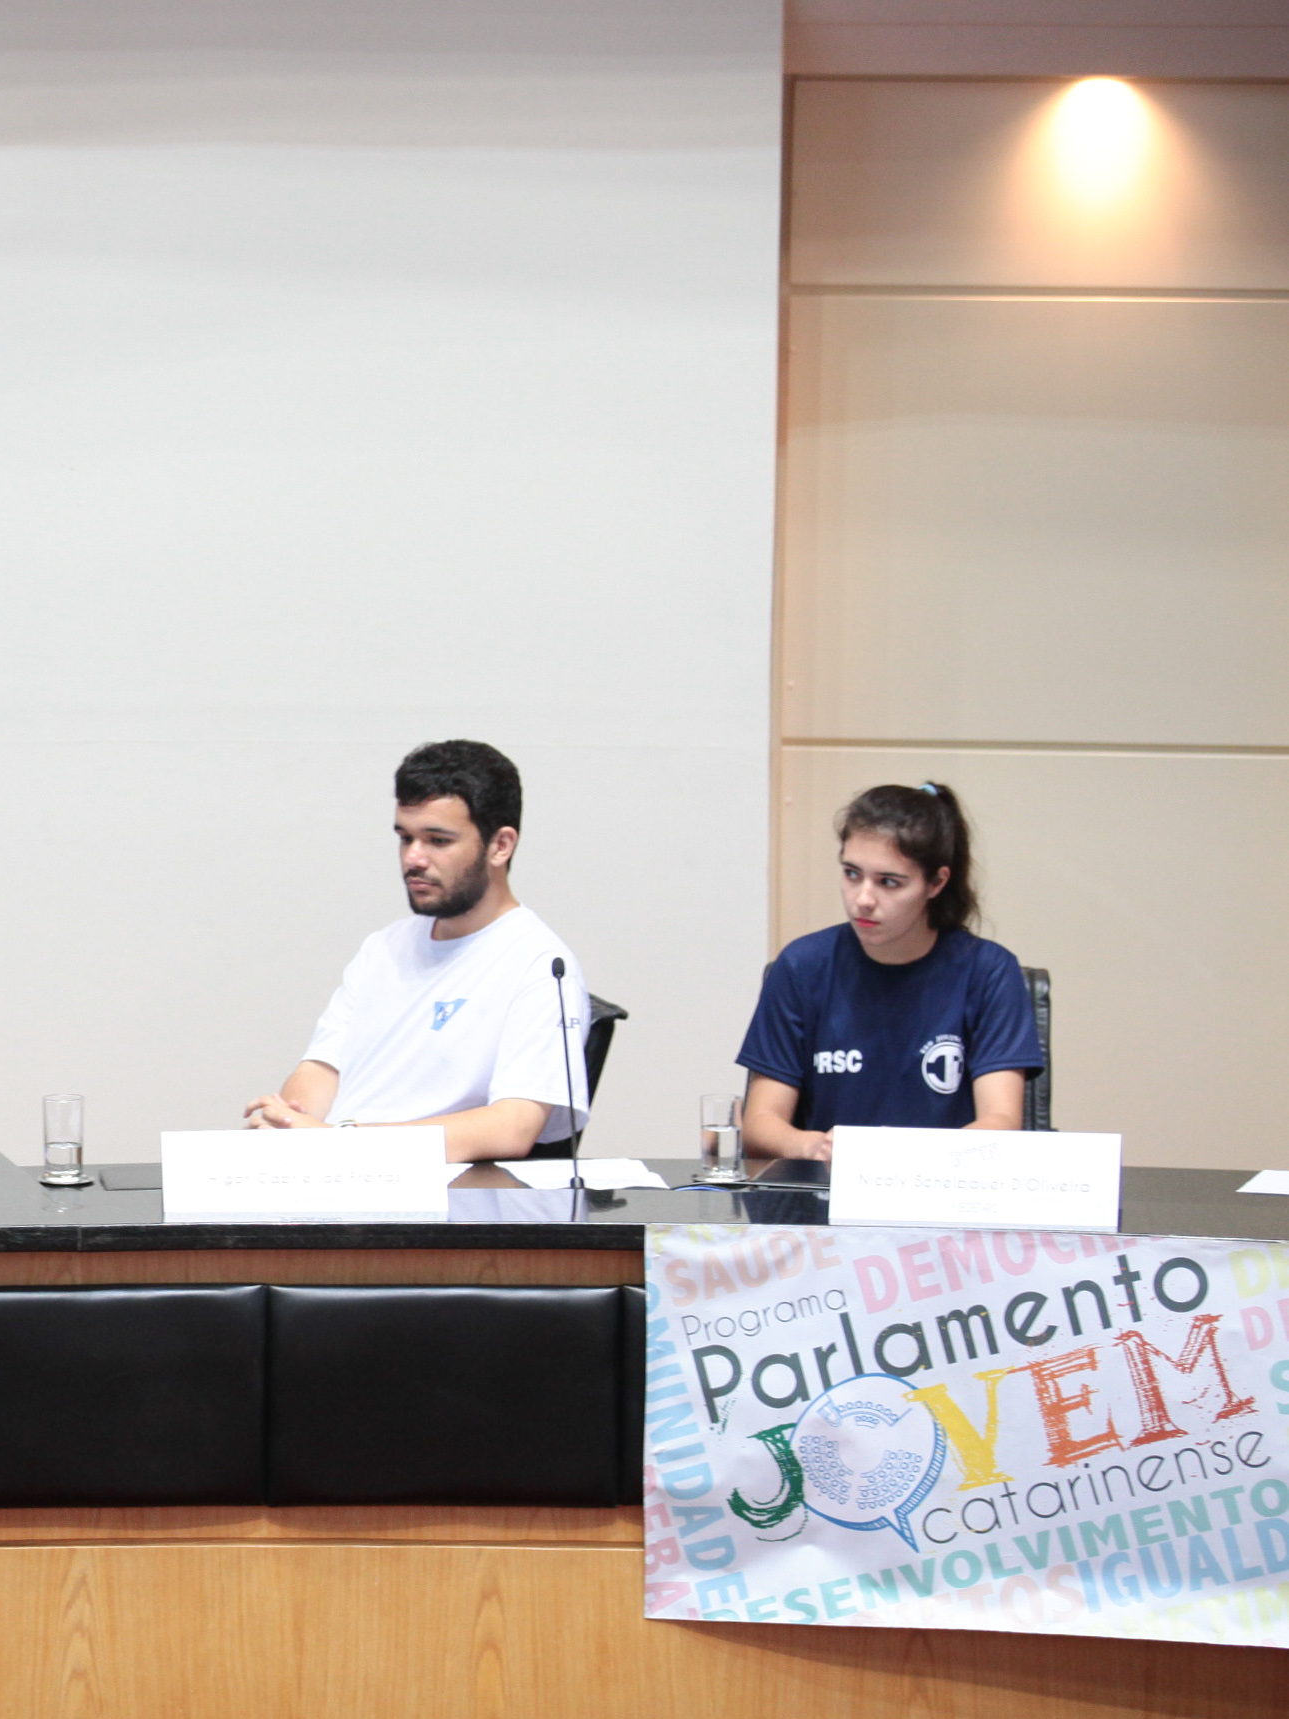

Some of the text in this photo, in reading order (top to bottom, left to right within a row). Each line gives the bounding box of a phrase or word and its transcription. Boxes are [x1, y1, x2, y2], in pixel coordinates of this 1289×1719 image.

[681, 1288, 847, 1345] Programa
[691, 1254, 1210, 1424] Parlamento
[727, 1314, 1258, 1550] JOVEM
[921, 1431, 1272, 1545] catarinense
